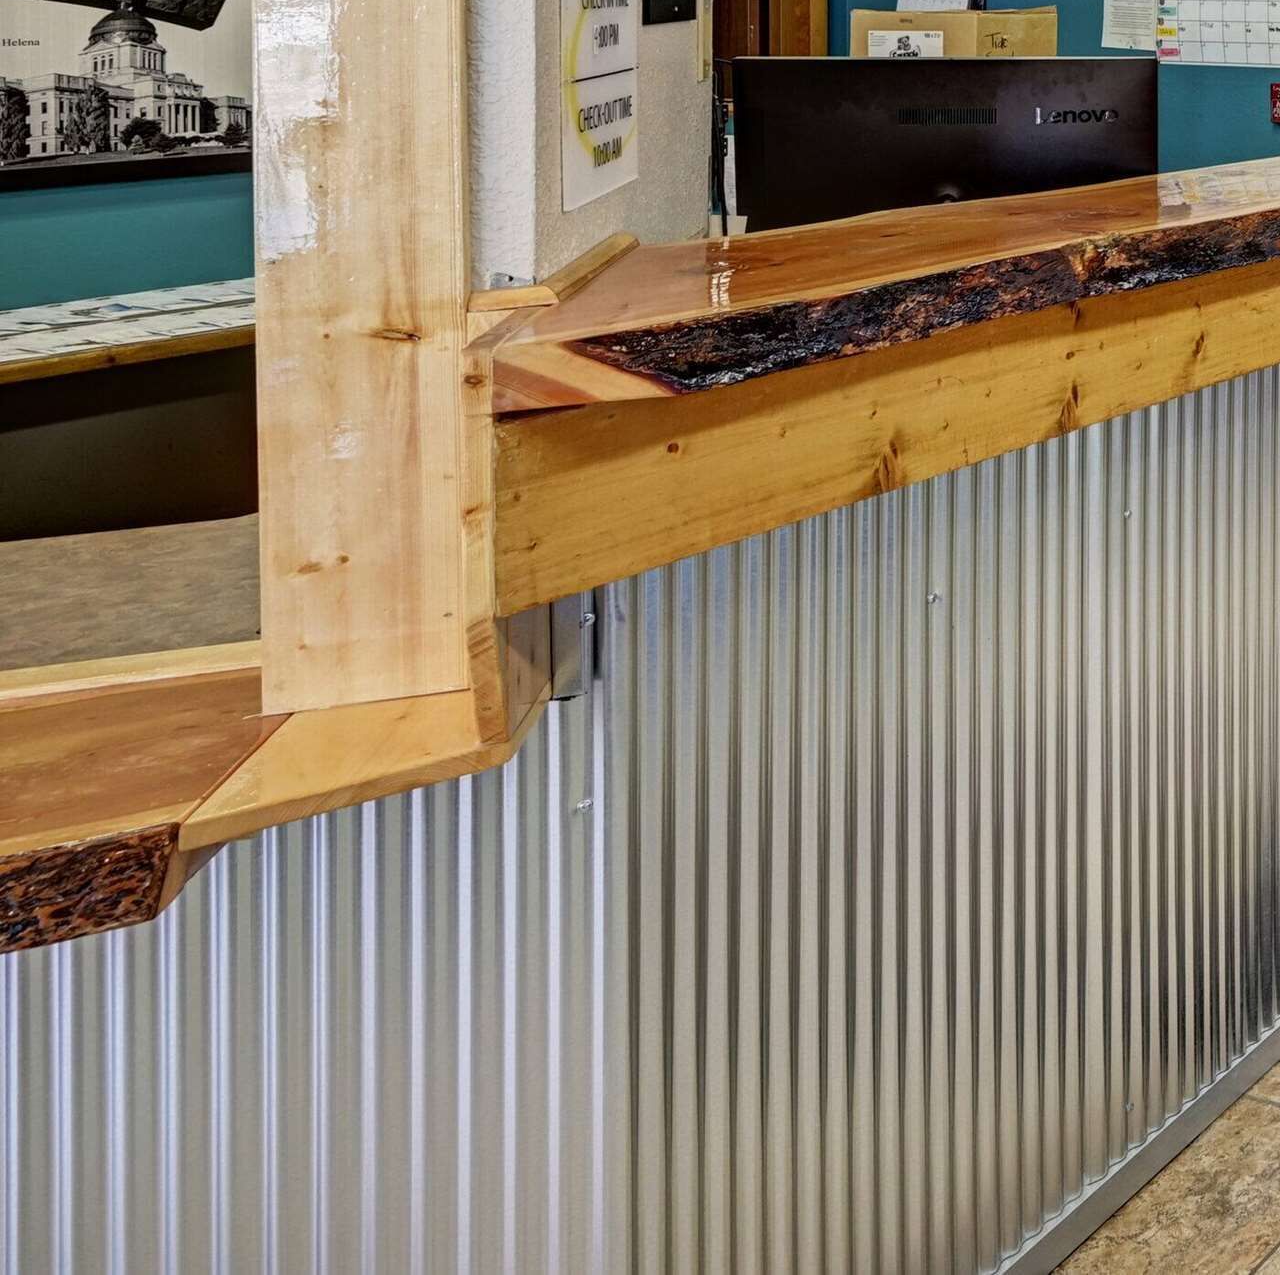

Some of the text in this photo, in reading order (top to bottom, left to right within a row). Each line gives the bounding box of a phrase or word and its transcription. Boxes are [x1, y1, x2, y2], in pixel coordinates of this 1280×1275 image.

[1, 37, 40, 47] Helena
[609, 24, 620, 46] PM
[617, 95, 632, 120] TIME
[1035, 107, 1119, 125] Lenovo
[593, 136, 623, 167] 10:00 AM
